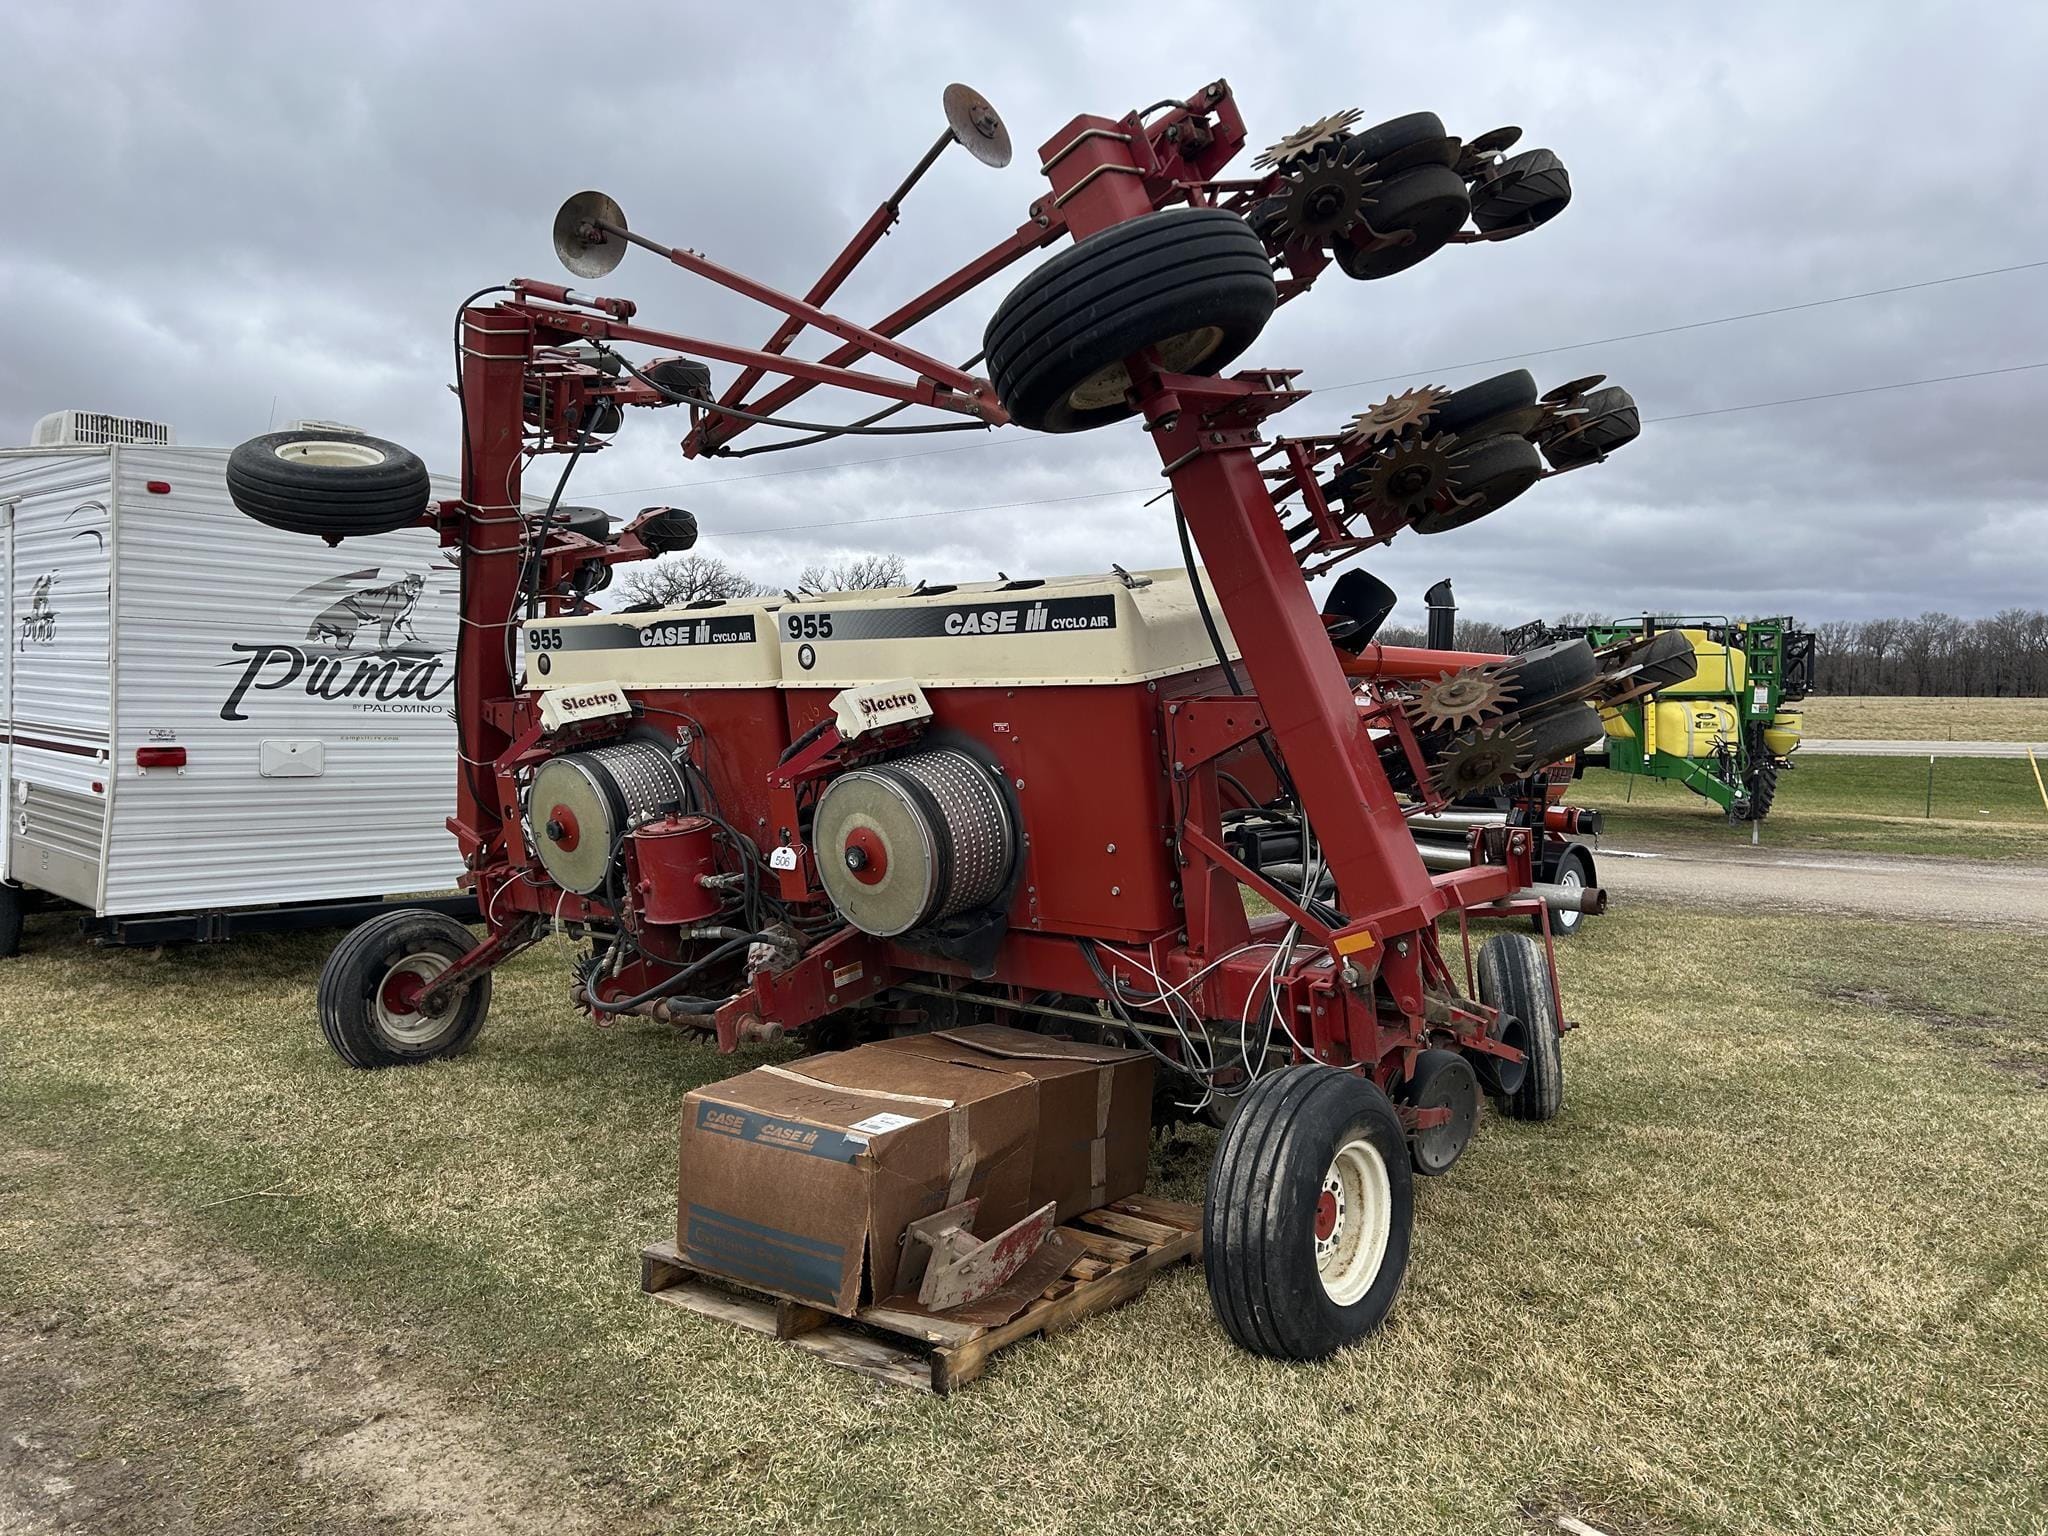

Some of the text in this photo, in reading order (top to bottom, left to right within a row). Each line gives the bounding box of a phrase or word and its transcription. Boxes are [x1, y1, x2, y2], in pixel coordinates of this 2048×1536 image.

[787, 613, 833, 640] 955
[944, 610, 1018, 636] CASE
[1051, 616, 1088, 630] CYCLO
[1090, 615, 1109, 628] AIR
[529, 628, 563, 650] 955
[640, 626, 690, 647] CASE
[712, 632, 737, 643] CYCLO
[739, 631, 752, 641] AIR
[219, 642, 455, 721] Puma
[363, 703, 443, 714] PALOMINO
[561, 691, 618, 711] Slectro
[859, 691, 917, 715] Slectro
[775, 855, 790, 867] 506
[705, 1109, 745, 1129] CASE
[761, 1123, 802, 1142] CASE
